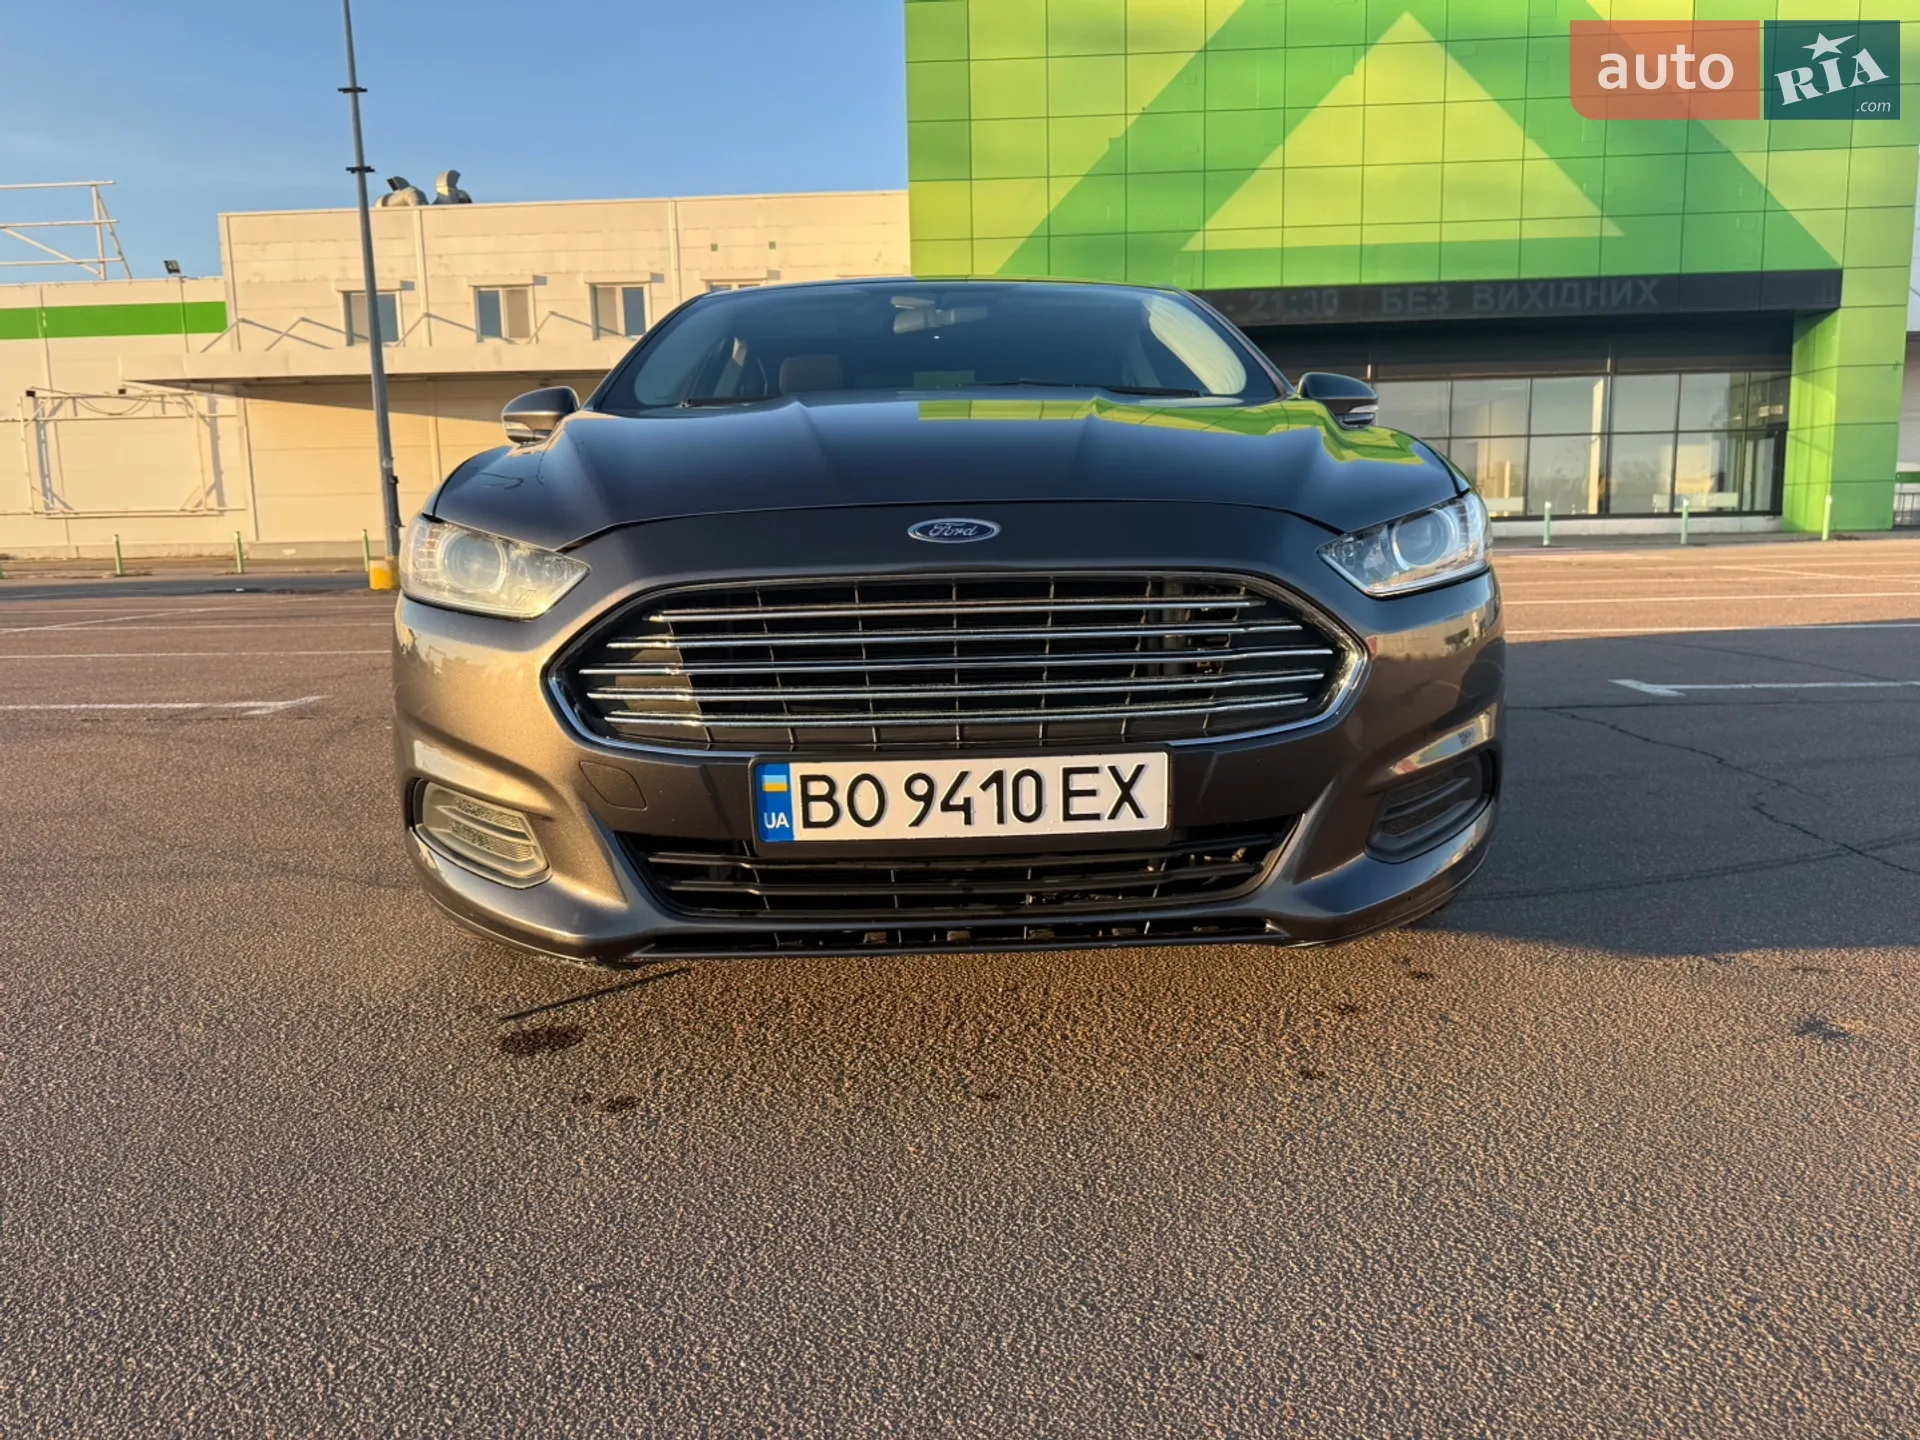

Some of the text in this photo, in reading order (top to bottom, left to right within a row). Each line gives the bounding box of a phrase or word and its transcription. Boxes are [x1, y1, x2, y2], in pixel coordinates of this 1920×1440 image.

[1381, 285, 1450, 314] БЕЗ
[1472, 279, 1660, 312] ВИХІДНИХ
[928, 522, 979, 536] Ford
[799, 764, 1147, 829] BO 9410 EX
[763, 812, 789, 829] UA
